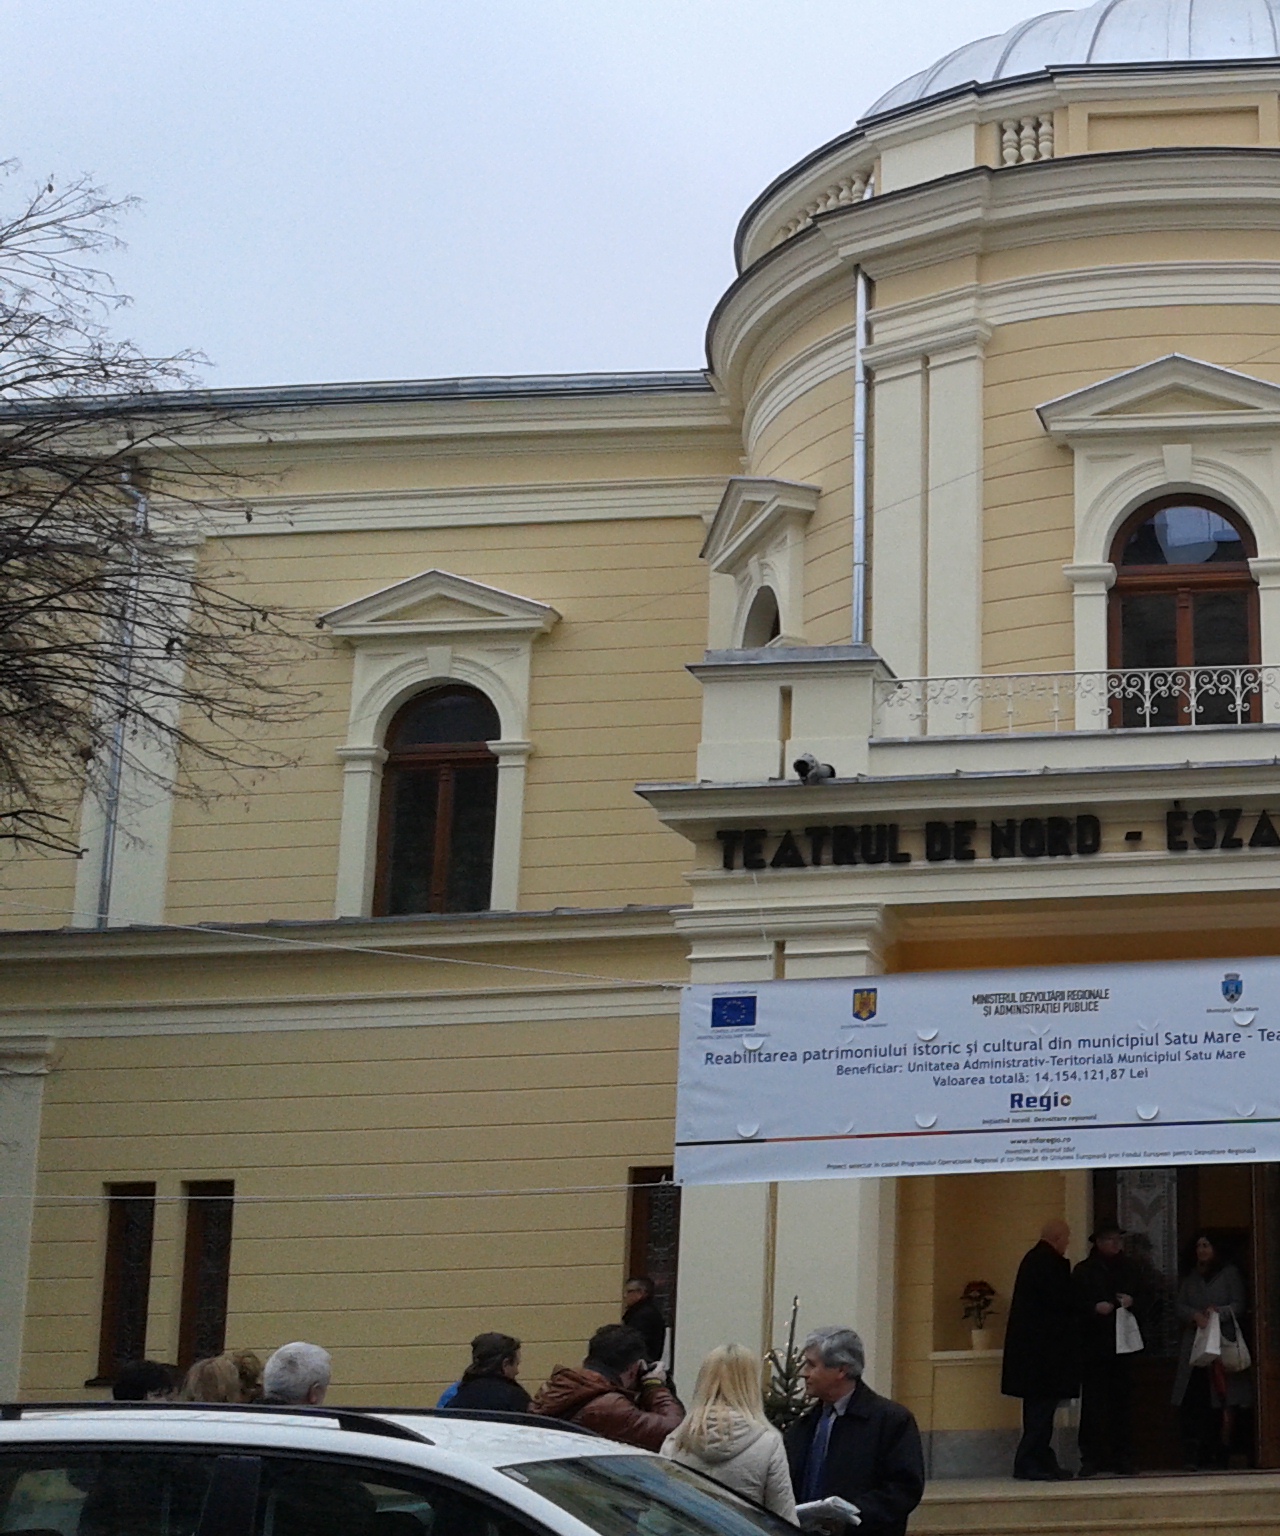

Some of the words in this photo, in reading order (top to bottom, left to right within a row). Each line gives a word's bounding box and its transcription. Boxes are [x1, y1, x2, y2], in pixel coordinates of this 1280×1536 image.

[717, 823, 911, 870] TEATRUL
[925, 820, 976, 861] DE
[991, 814, 1100, 859] NORD
[972, 992, 1018, 1005] MINISTERUL
[1067, 988, 1110, 1000] REGIONALE
[1063, 1001, 1099, 1012] PUBLICE
[704, 1050, 798, 1066] Reabilitarea
[802, 1044, 907, 1064] patrimoniului
[913, 1041, 961, 1056] istoric
[983, 1037, 1043, 1053] cultural
[1048, 1035, 1073, 1050] din
[1078, 1033, 1160, 1049] municipiul
[1165, 1032, 1198, 1045] Satu
[1203, 1031, 1241, 1044] Mare
[836, 1064, 902, 1076] Beneficiar:
[908, 1060, 960, 1073] Unitatea
[963, 1053, 1114, 1070] Administrativ-Teritorială
[1117, 1050, 1181, 1064] Municipiul
[1185, 1050, 1212, 1061] Satu
[1216, 1048, 1246, 1060] Mare
[933, 1074, 985, 1087] Valoarea
[1035, 1068, 1125, 1083] 14.154.121,87
[1130, 1067, 1149, 1079] Lei
[1010, 1091, 1072, 1112] Regio
